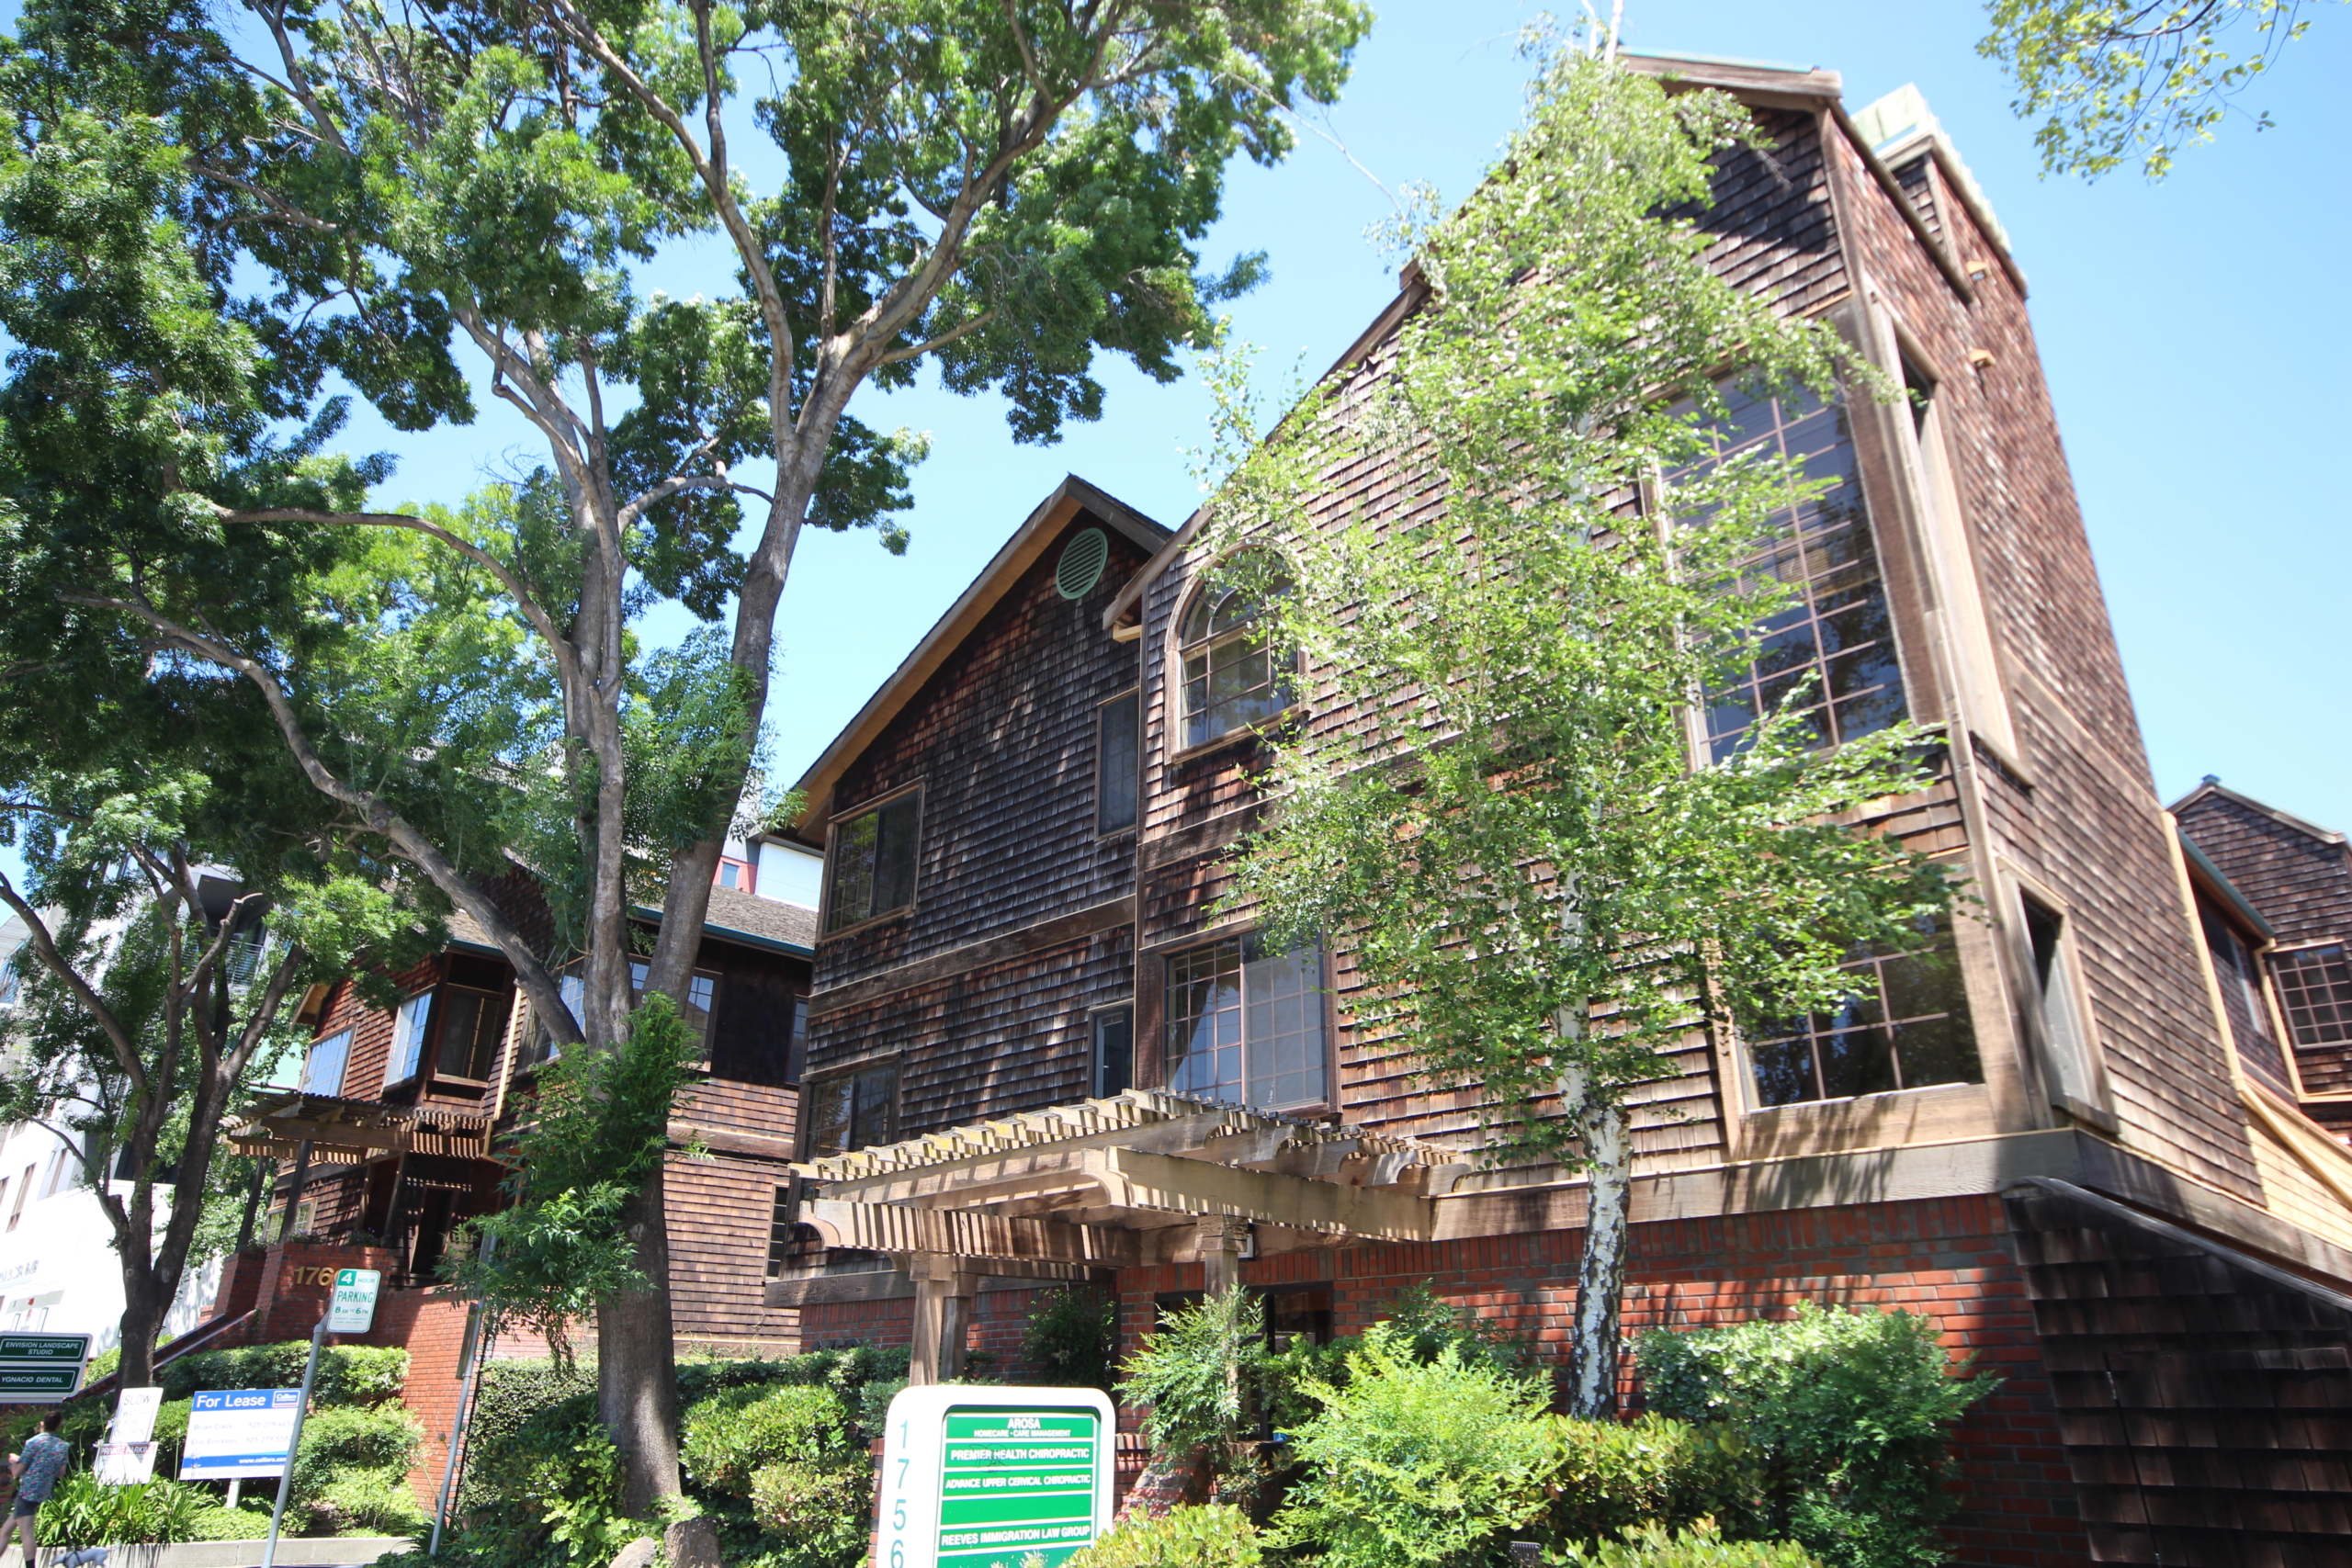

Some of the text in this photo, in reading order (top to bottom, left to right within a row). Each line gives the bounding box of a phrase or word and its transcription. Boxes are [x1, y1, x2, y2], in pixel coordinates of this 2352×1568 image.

[294, 1267, 339, 1286] 176
[341, 1272, 353, 1283] 4
[336, 1291, 374, 1303] PARKING
[123, 1394, 152, 1405] SLOW
[197, 1394, 266, 1408] For Lease
[1007, 1417, 1041, 1429] AROSA
[974, 1429, 1071, 1438] HOMECARE CARE MANAGEMENT
[100, 1445, 155, 1455] PRIVATE PARKING
[951, 1448, 1090, 1461] PREMIER HEALTH CHIROPRACTIC
[945, 1474, 1091, 1489] ADVANCE UPPER CERVICAL CHIROPRACTIC
[890, 1419, 910, 1568] 1756
[942, 1525, 1091, 1546] REEVES IMMIGRATION LAW GROUP
